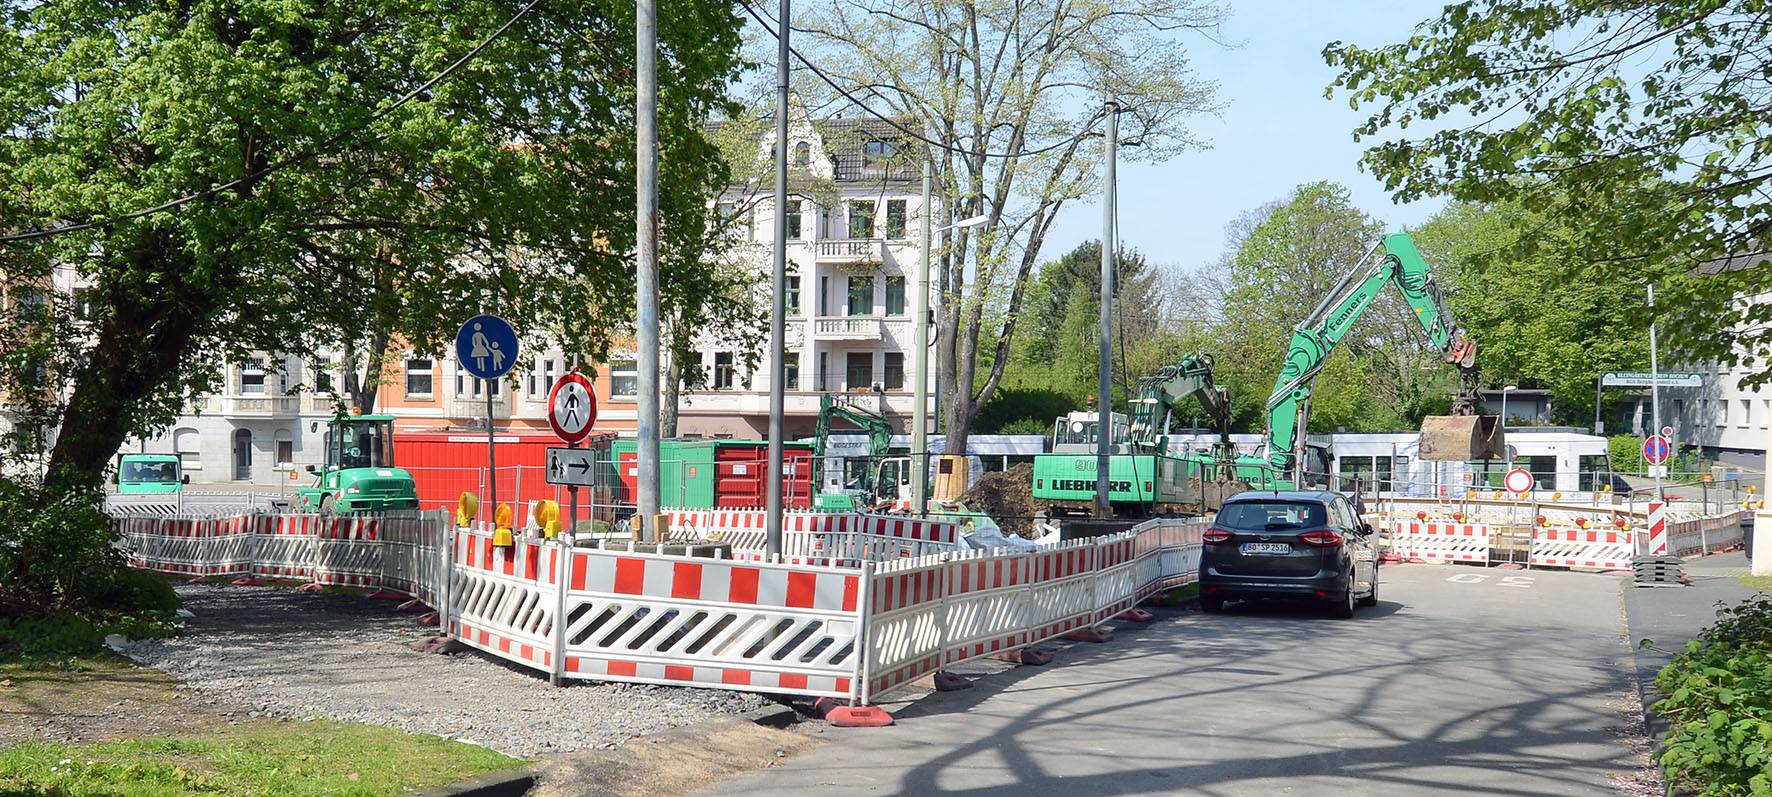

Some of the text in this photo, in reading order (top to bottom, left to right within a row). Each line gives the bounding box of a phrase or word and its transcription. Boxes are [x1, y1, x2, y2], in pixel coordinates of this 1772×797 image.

[1328, 292, 1367, 331] Fenners
[1052, 479, 1132, 492] LIEBHRR
[1271, 544, 1288, 552] 2516
